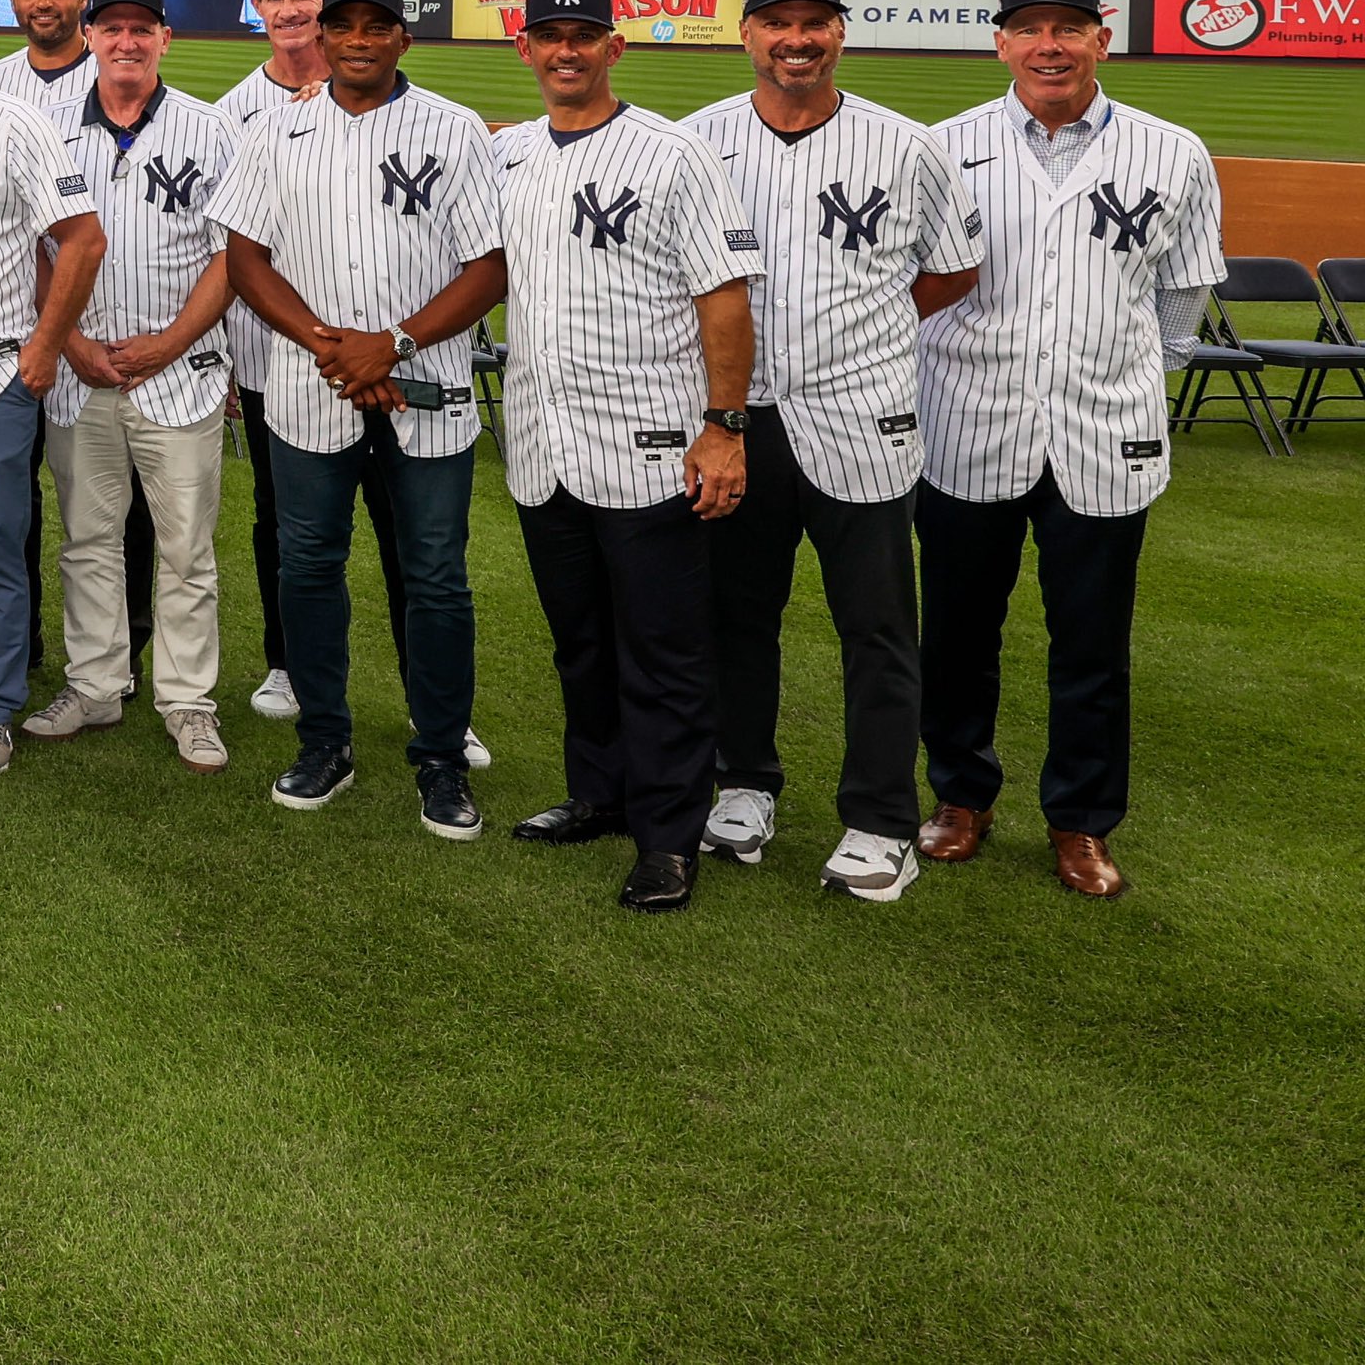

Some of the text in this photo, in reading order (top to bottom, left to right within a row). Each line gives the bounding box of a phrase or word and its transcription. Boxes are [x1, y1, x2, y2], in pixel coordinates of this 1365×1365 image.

[421, 2, 440, 13] APP
[861, 6, 896, 23] OF
[1200, 5, 1246, 32] WEBB
[682, 24, 723, 34] Preferred
[682, 32, 715, 40] Partner
[1268, 31, 1348, 46] Plumbing,
[57, 175, 84, 189] STARR
[143, 154, 203, 213] NY
[378, 151, 443, 216] NY
[571, 180, 642, 249] NY
[817, 180, 892, 252] NY
[1088, 181, 1164, 253] NY
[726, 231, 756, 242] STARR
